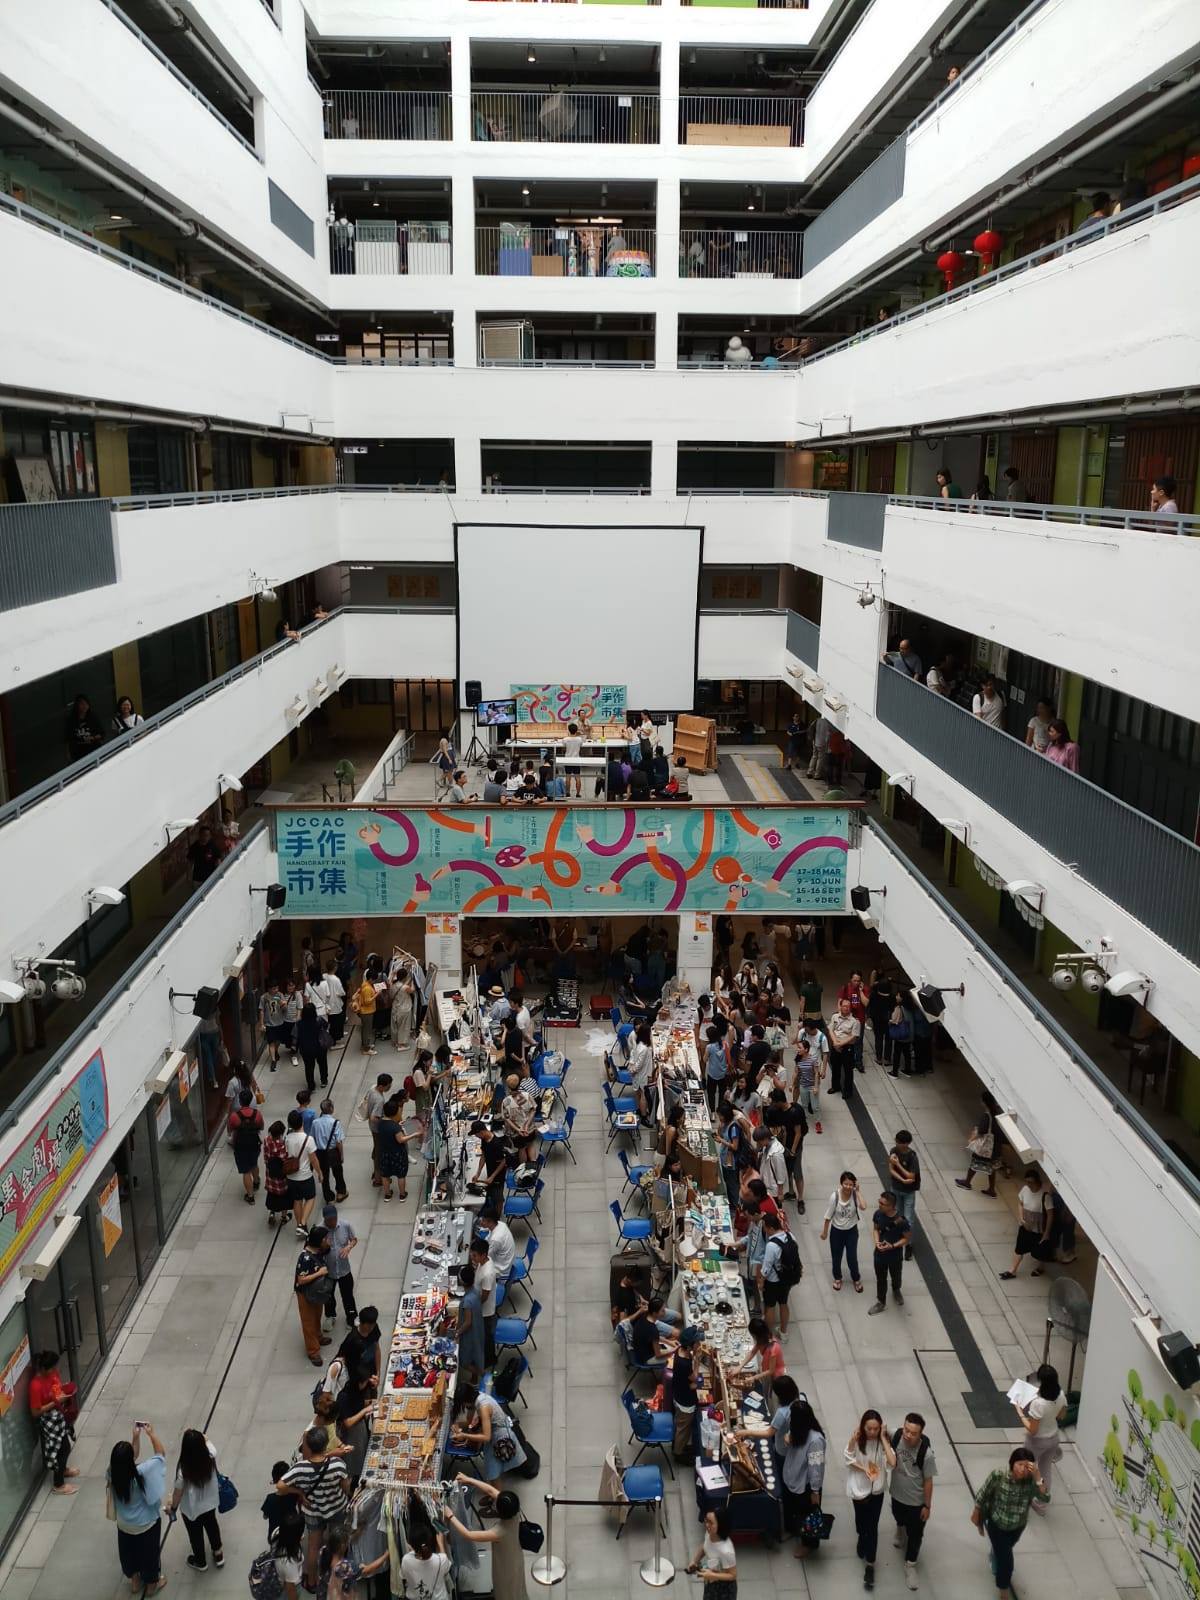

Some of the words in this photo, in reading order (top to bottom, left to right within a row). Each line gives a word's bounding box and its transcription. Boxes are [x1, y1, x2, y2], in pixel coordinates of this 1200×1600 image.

[602, 693, 624, 703] 手作
[602, 707, 624, 718] 市集
[285, 817, 345, 828] JCCAC
[285, 830, 346, 858] 手作
[286, 868, 347, 895] 市集
